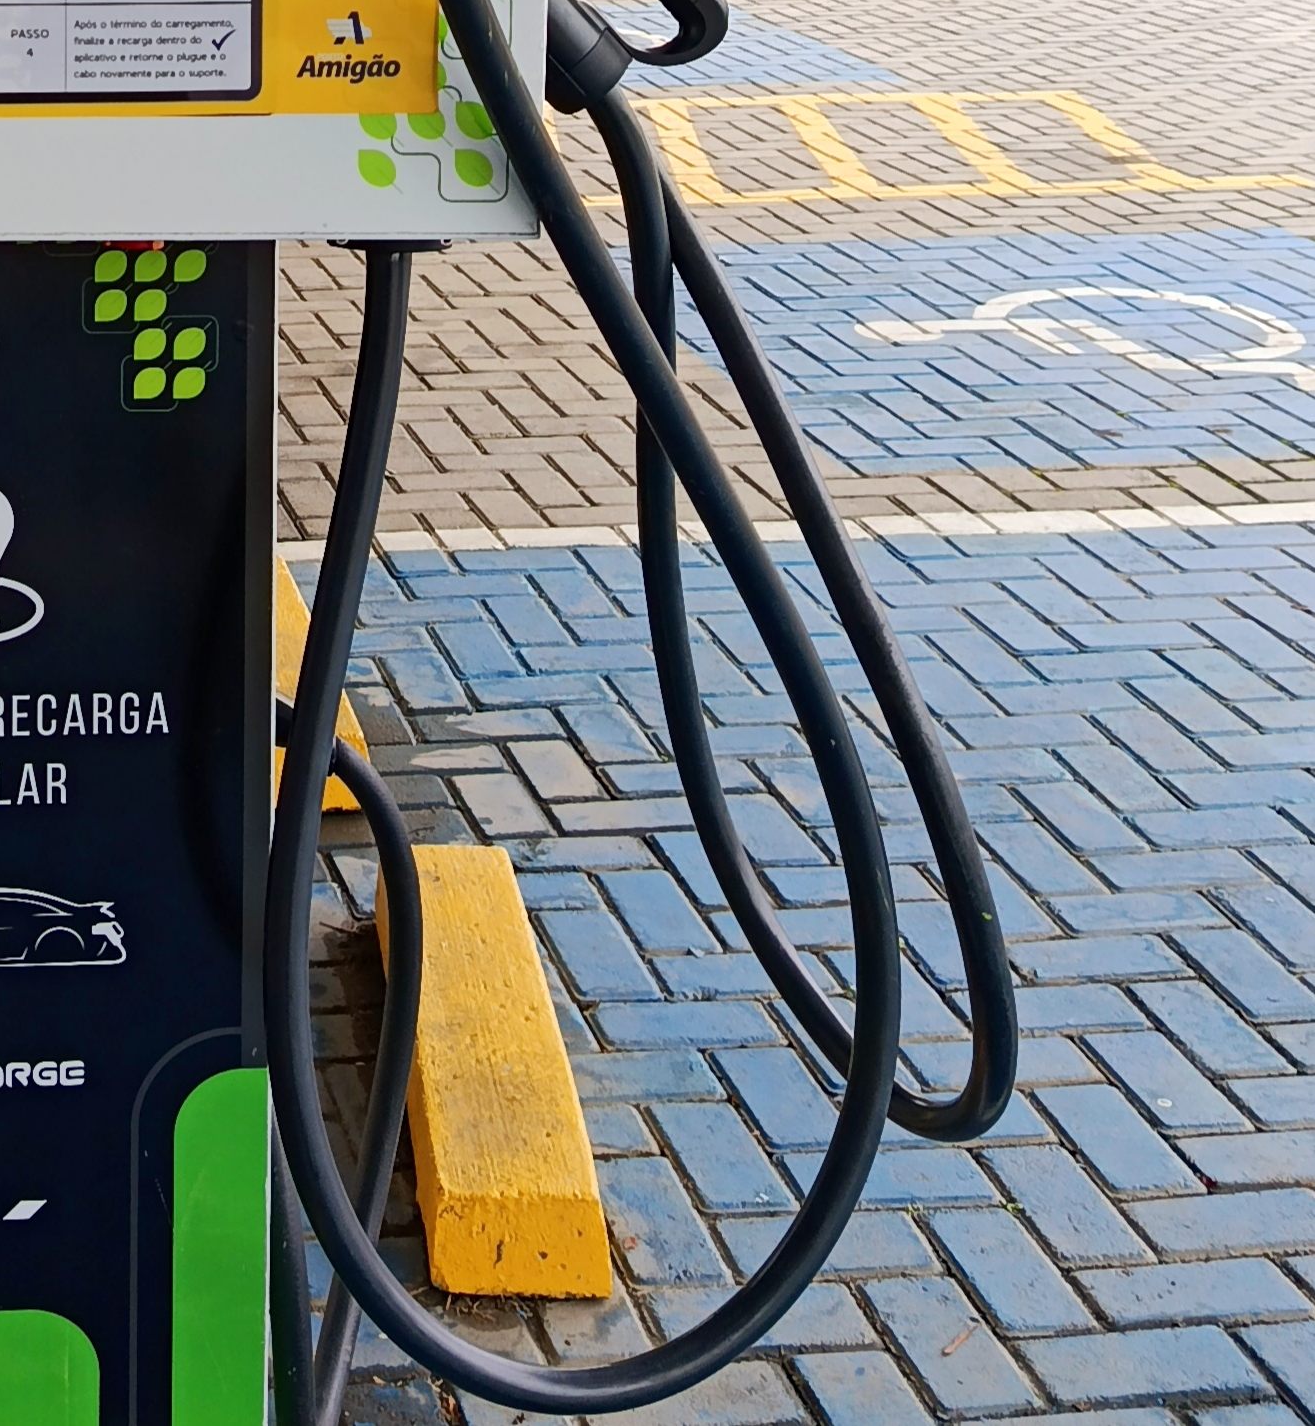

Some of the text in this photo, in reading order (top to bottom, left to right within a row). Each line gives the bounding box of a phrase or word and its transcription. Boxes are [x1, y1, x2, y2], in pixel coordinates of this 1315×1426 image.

[74, 20, 96, 30] Após
[111, 20, 147, 28] término
[151, 20, 162, 28] do
[11, 29, 49, 39] PASSO
[74, 37, 104, 45] finalize
[118, 38, 152, 46] recarga
[156, 36, 186, 44] dentro
[190, 36, 202, 44] do
[27, 48, 33, 57] 4
[74, 54, 117, 63] aplicativo
[177, 53, 206, 62] plugue
[297, 54, 400, 83] Amigão
[74, 70, 96, 78] cabo
[101, 70, 151, 78] novamente
[155, 71, 175, 79] para
[189, 70, 226, 78] suporte.
